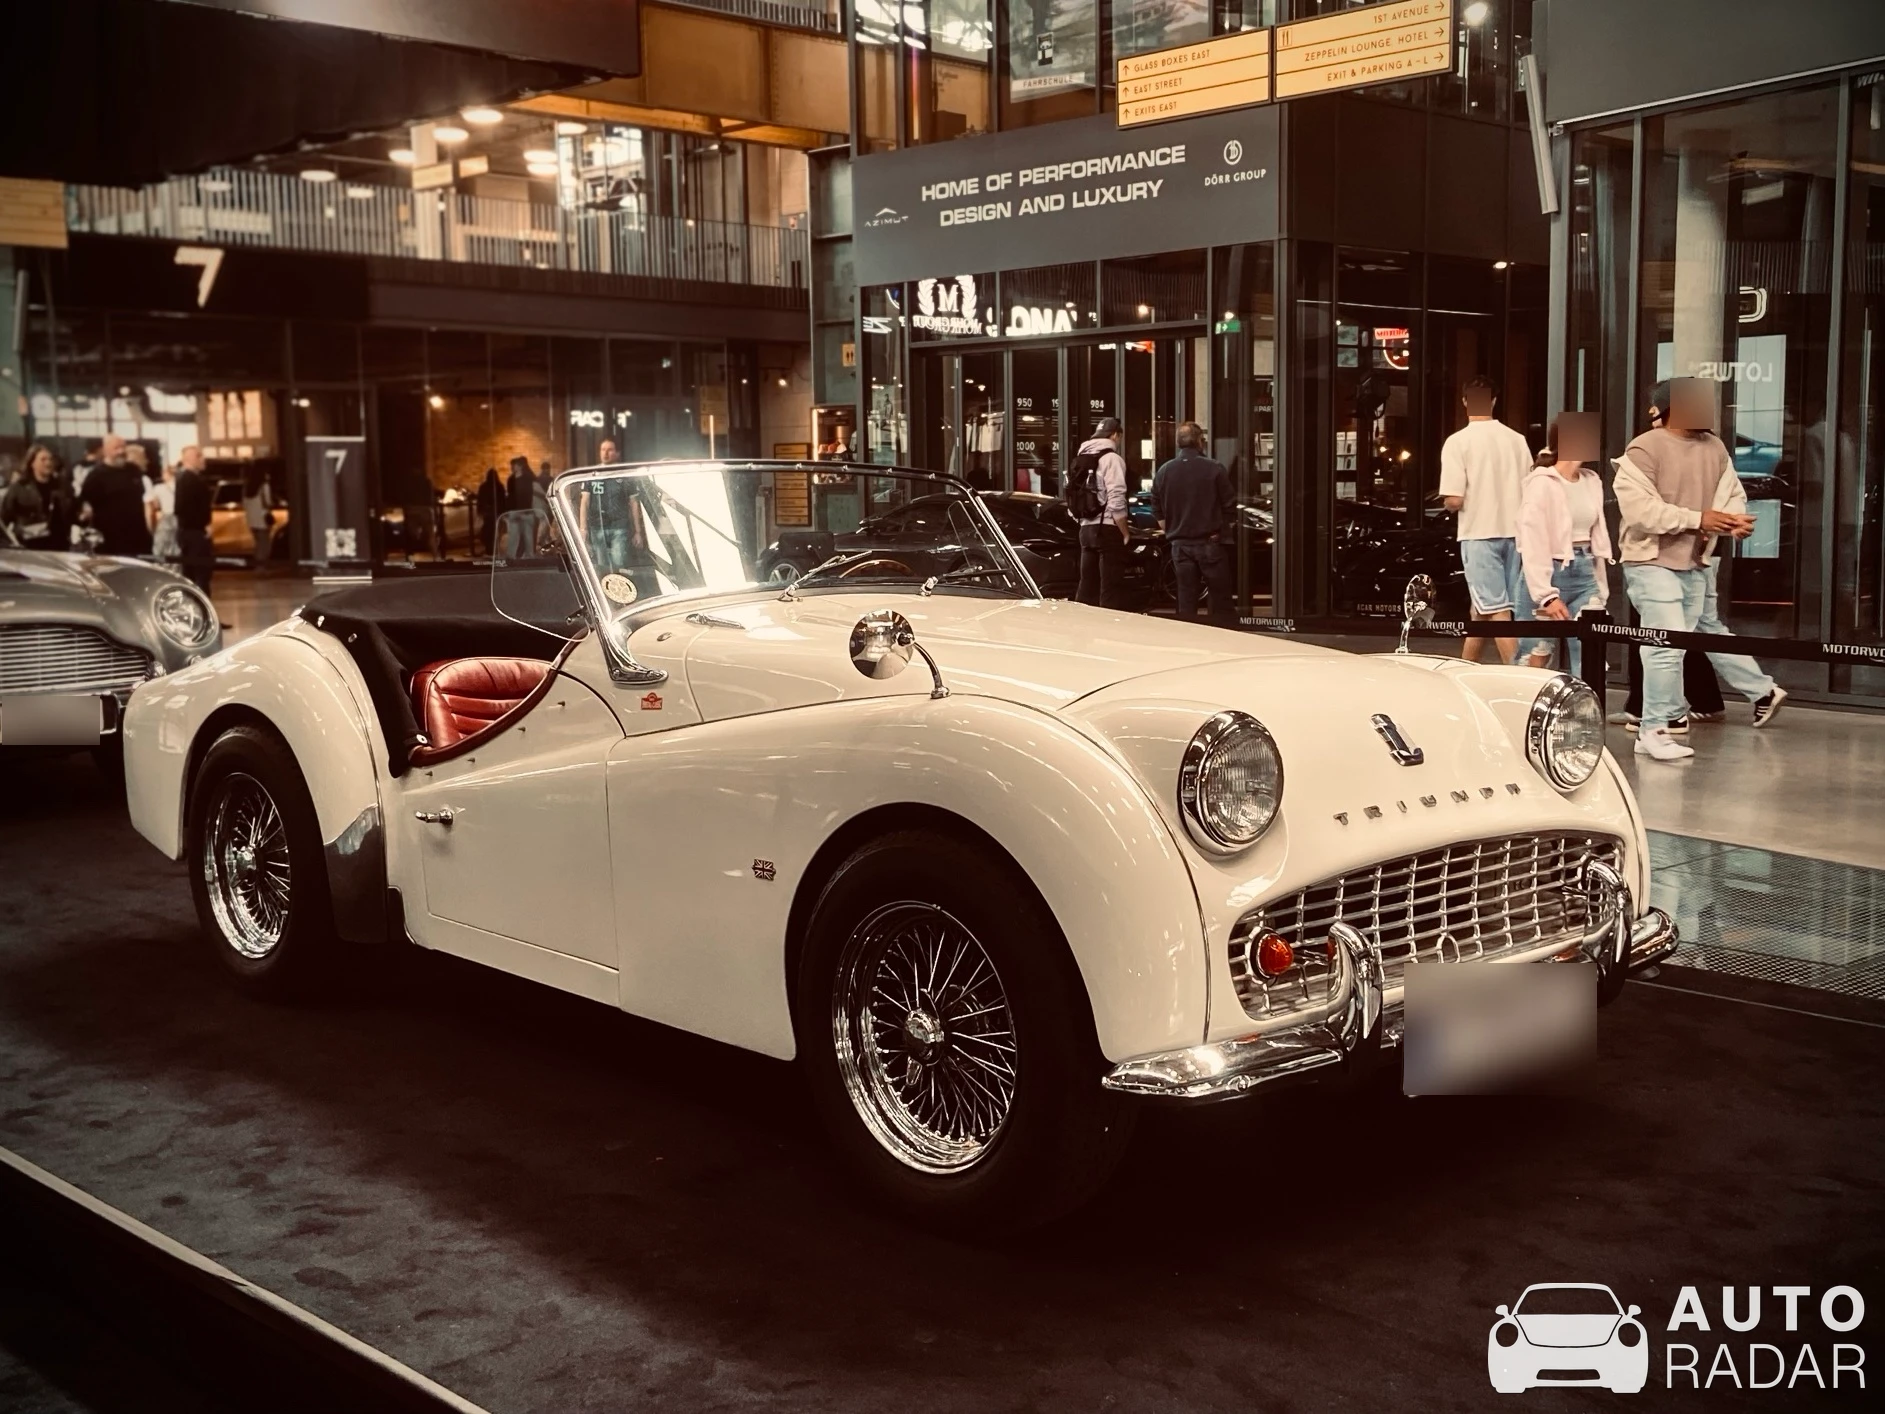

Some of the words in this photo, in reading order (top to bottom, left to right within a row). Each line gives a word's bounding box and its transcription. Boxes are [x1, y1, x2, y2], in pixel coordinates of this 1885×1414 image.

[1373, 13, 1388, 24] 1ST
[1391, 4, 1430, 21] AVENUE
[1304, 46, 1348, 62] ZEPPELIN
[1351, 37, 1391, 54] LOUNGE
[1398, 31, 1428, 44] HOTEL
[1134, 60, 1158, 73] GLASS
[1161, 55, 1188, 67] BOXES
[1191, 49, 1210, 61] EAST
[1327, 70, 1346, 82] EXIT
[1350, 68, 1357, 77] &
[1361, 60, 1403, 75] PARKING
[1406, 58, 1413, 67] A
[1423, 56, 1428, 65] L
[1023, 76, 1074, 88] FAHRSCHULE
[1134, 83, 1151, 95] EAST
[1155, 77, 1183, 90] STREET
[1134, 104, 1156, 117] EXITS
[1159, 101, 1177, 113] EAST
[921, 177, 980, 202] HOME
[985, 172, 1013, 192] OF
[1018, 144, 1186, 187] PERFORMANCE
[1204, 173, 1231, 186] DÖRR
[1233, 168, 1267, 182] GROUP
[940, 201, 1012, 227] DESIGN
[1018, 193, 1065, 216] AND
[1072, 178, 1164, 209] LUXURY
[864, 215, 909, 227] AZIMUT
[174, 246, 225, 308] 7
[325, 449, 348, 474] 7
[1239, 616, 1294, 627] MOTORWORLD
[1591, 623, 1668, 639] MOTORWORLD
[1332, 783, 1522, 826] TRIUMPH
